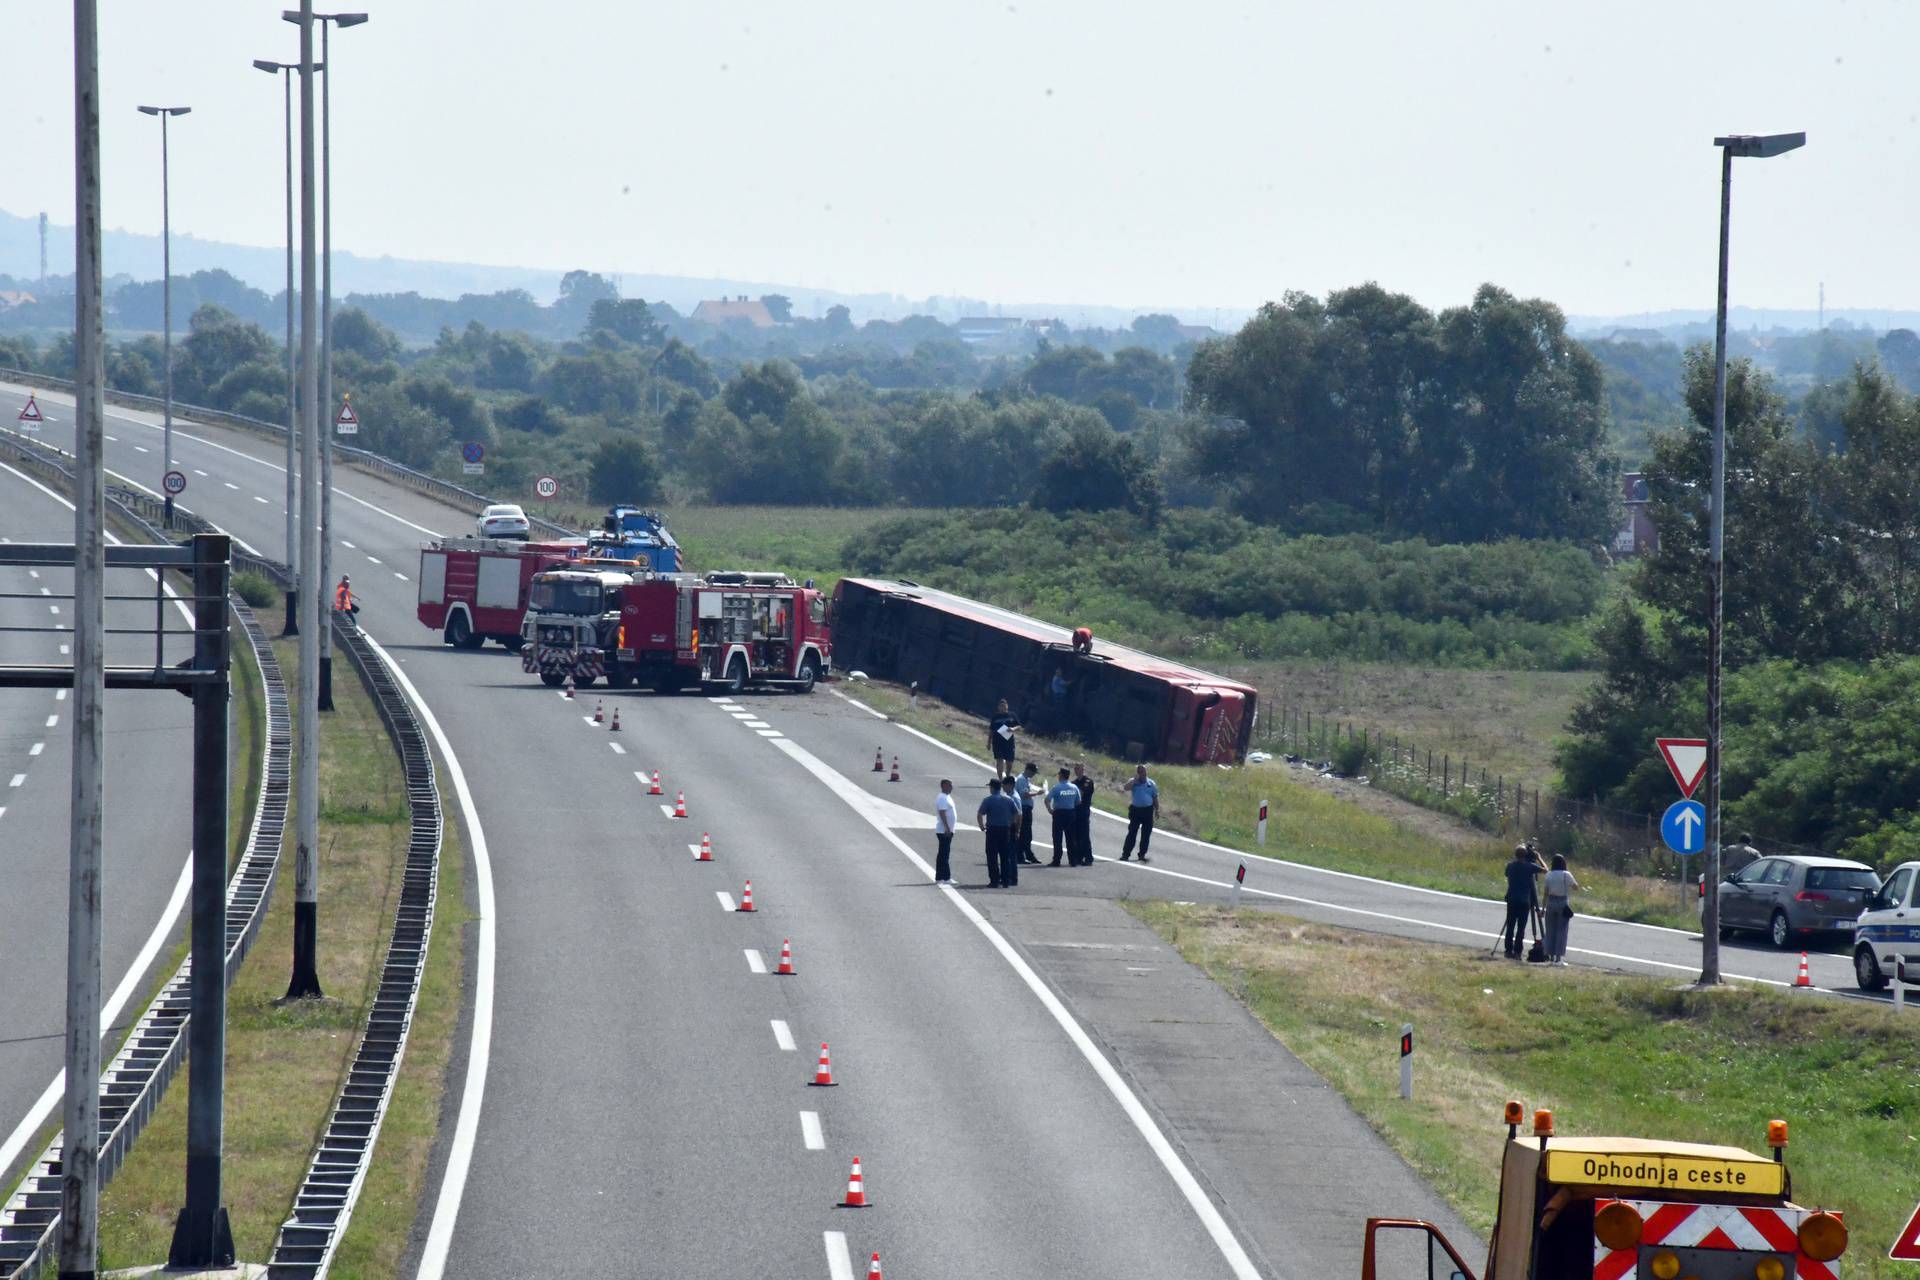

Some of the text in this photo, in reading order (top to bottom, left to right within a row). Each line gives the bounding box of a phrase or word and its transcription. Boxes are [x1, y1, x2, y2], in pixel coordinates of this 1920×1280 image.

[167, 477, 182, 488] 100
[540, 481, 554, 493] 100
[1584, 1159, 1746, 1185] Ophodnja ceste
